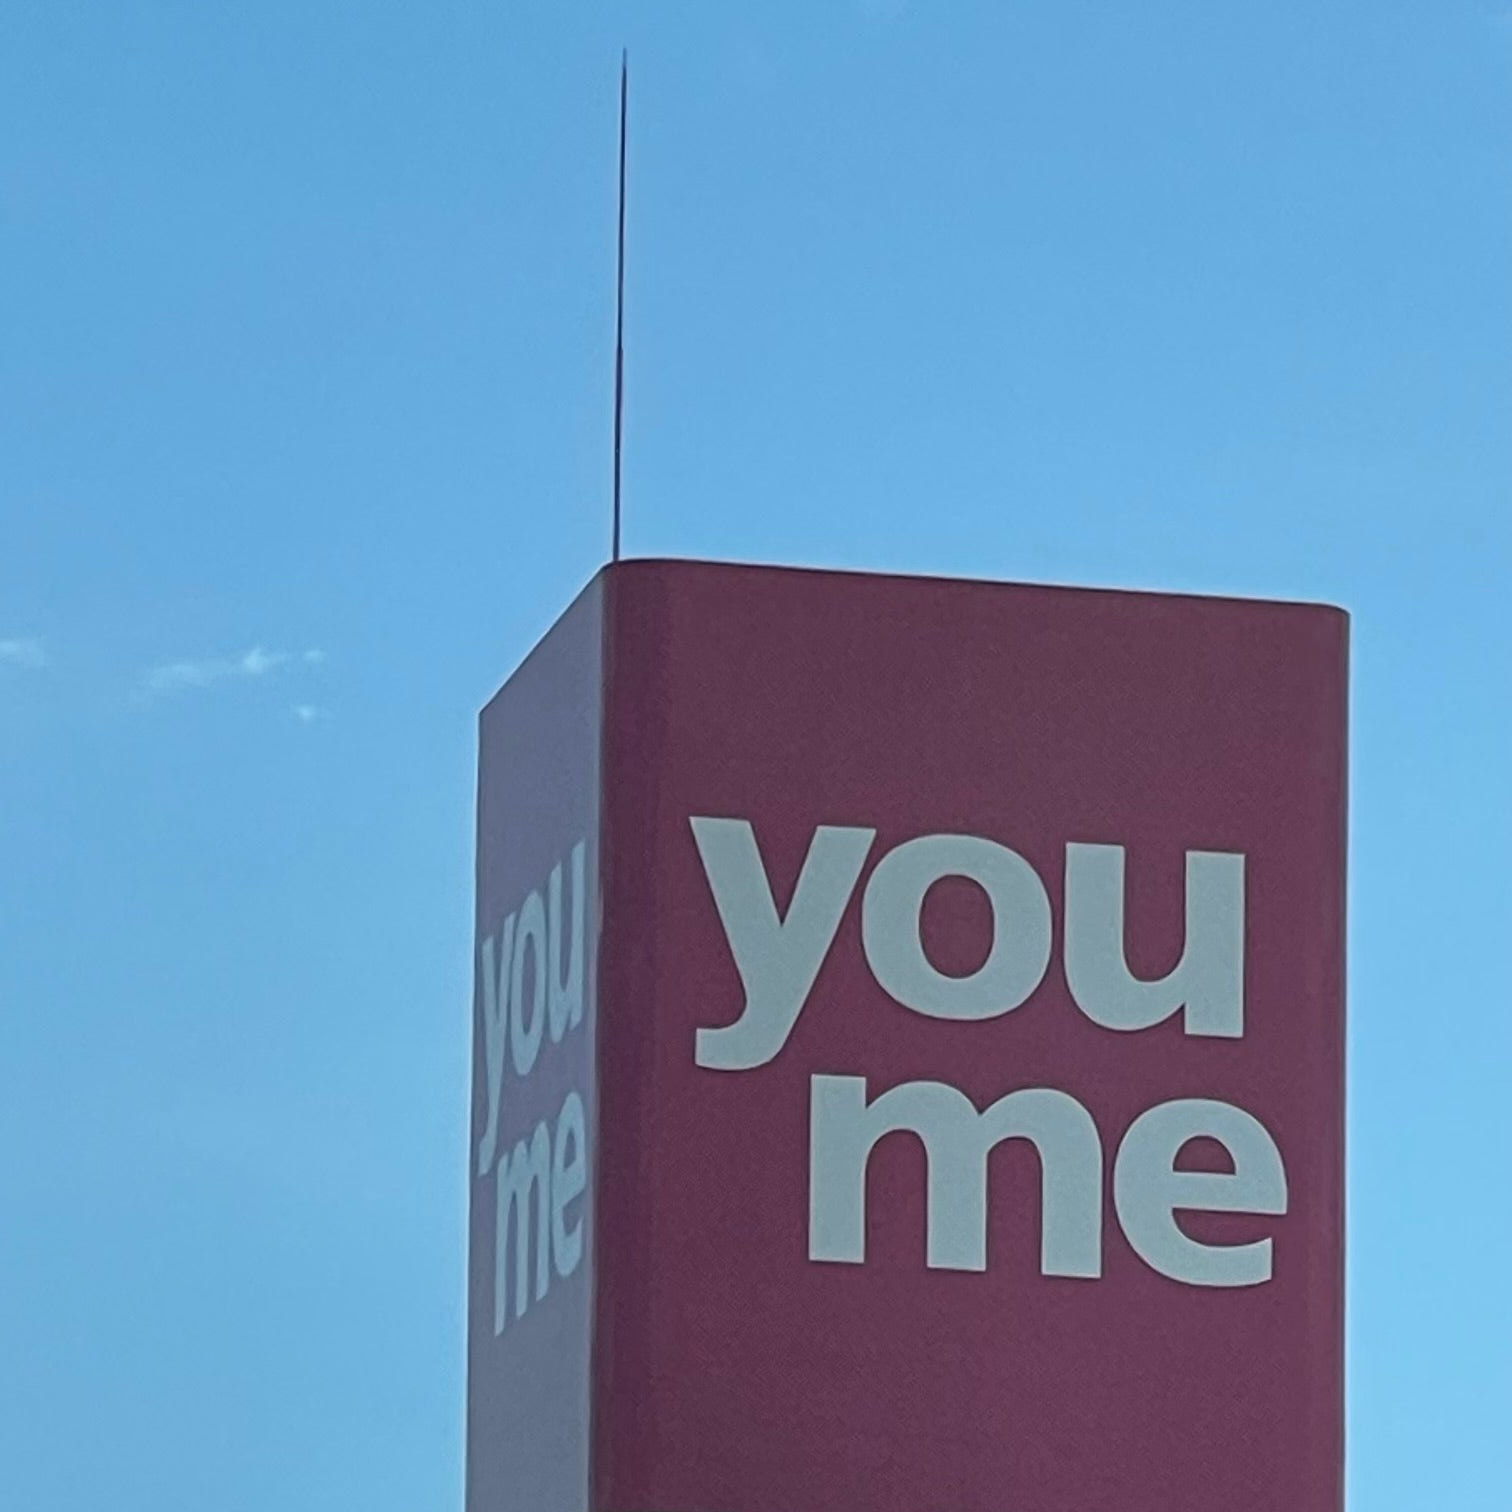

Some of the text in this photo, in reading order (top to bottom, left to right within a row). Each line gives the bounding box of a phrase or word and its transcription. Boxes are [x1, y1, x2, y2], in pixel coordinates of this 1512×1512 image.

[478, 839, 585, 1177] you
[689, 816, 1245, 1071] you
[494, 1091, 586, 1337] me
[808, 1074, 1287, 1287] me
